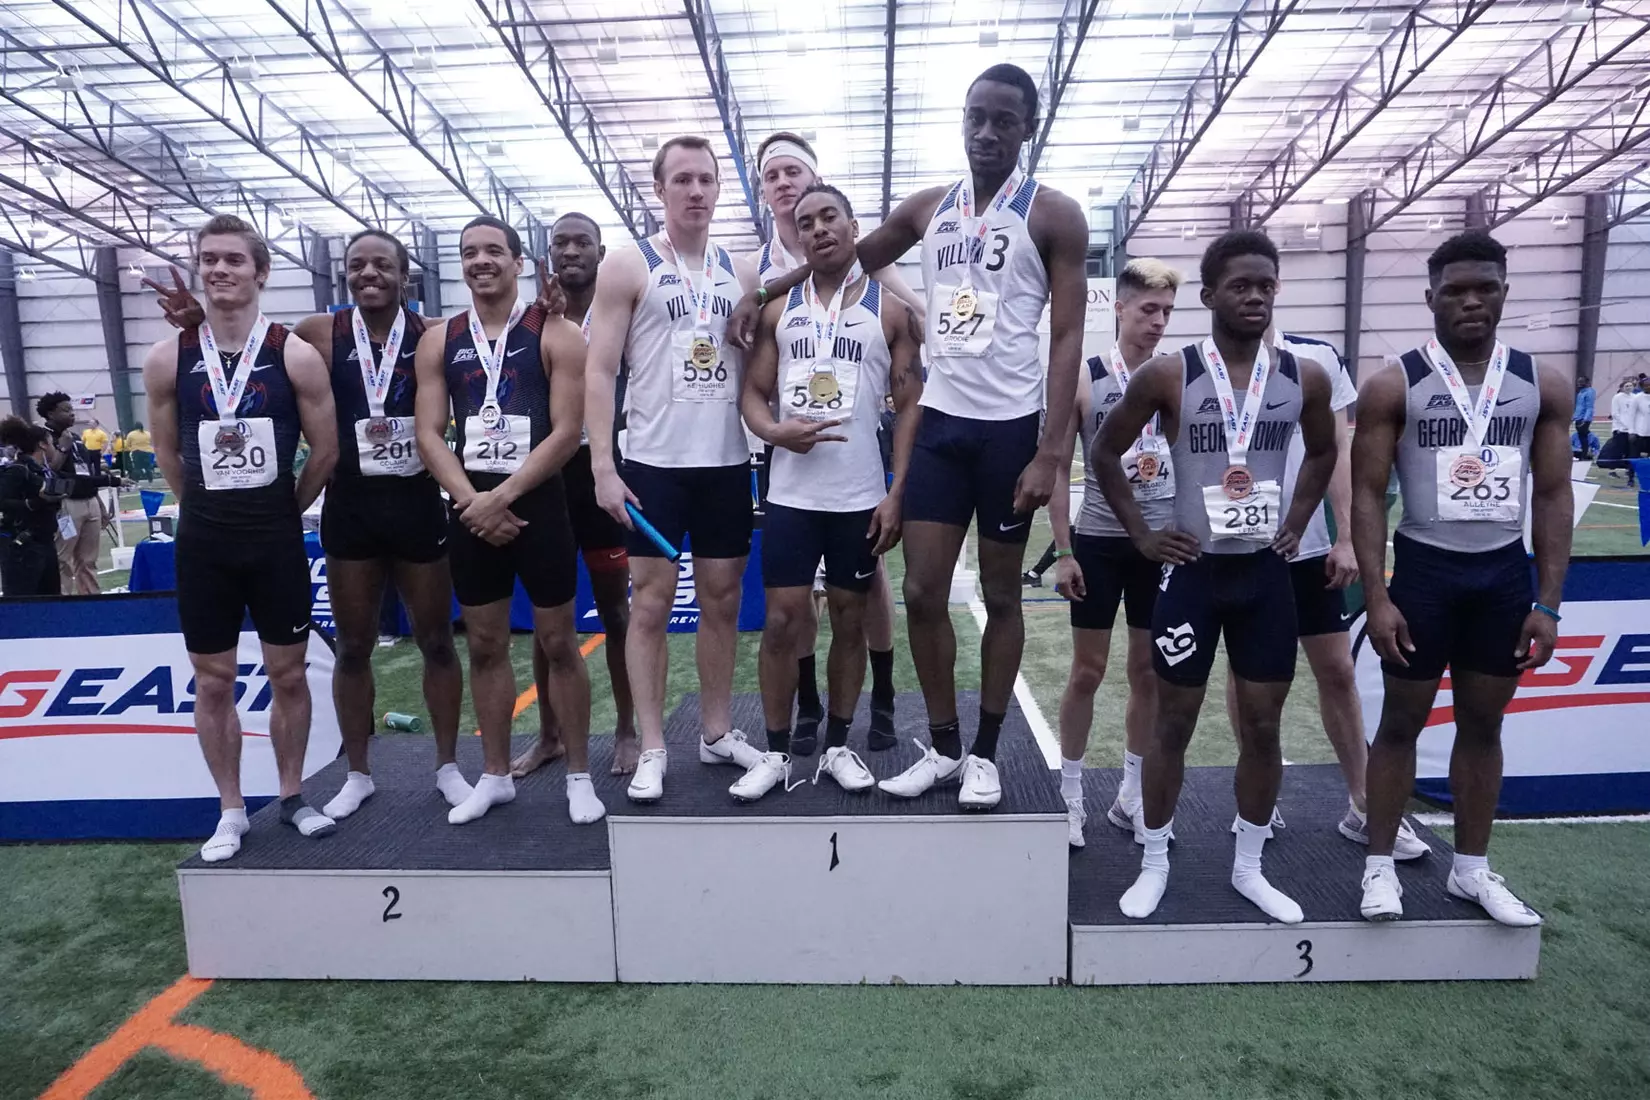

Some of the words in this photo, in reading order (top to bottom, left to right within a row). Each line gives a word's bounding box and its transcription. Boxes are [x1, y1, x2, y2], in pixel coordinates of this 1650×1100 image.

[985, 234, 1010, 271] 3
[937, 312, 985, 336] 527
[373, 440, 412, 460] 201
[477, 441, 517, 461] 212
[1127, 462, 1169, 483] 24
[1223, 504, 1269, 529] 281
[828, 832, 840, 872] 1
[381, 885, 403, 922] 2
[1293, 939, 1314, 979] 3
